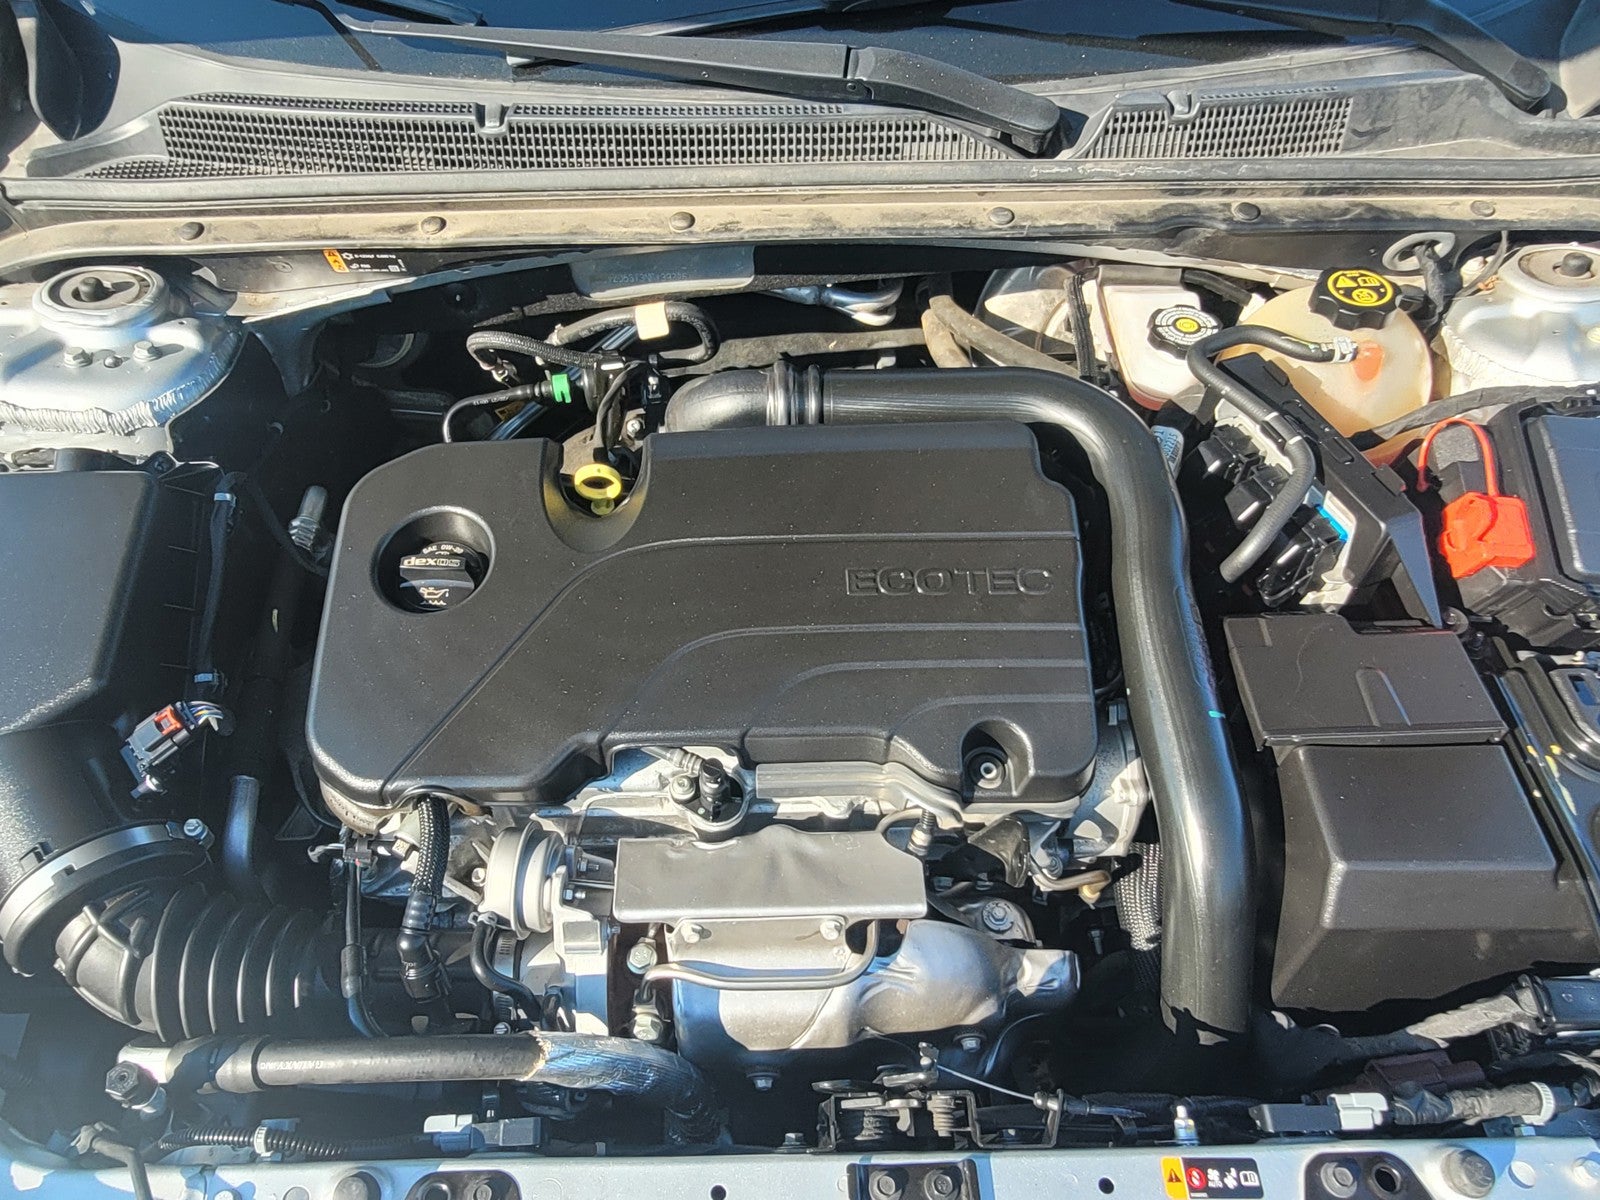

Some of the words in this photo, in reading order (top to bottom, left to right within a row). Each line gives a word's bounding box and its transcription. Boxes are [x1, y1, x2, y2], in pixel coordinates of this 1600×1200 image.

[422, 545, 437, 554] SAE
[403, 557, 460, 567] dexos
[845, 566, 1055, 596] ECOTEC
